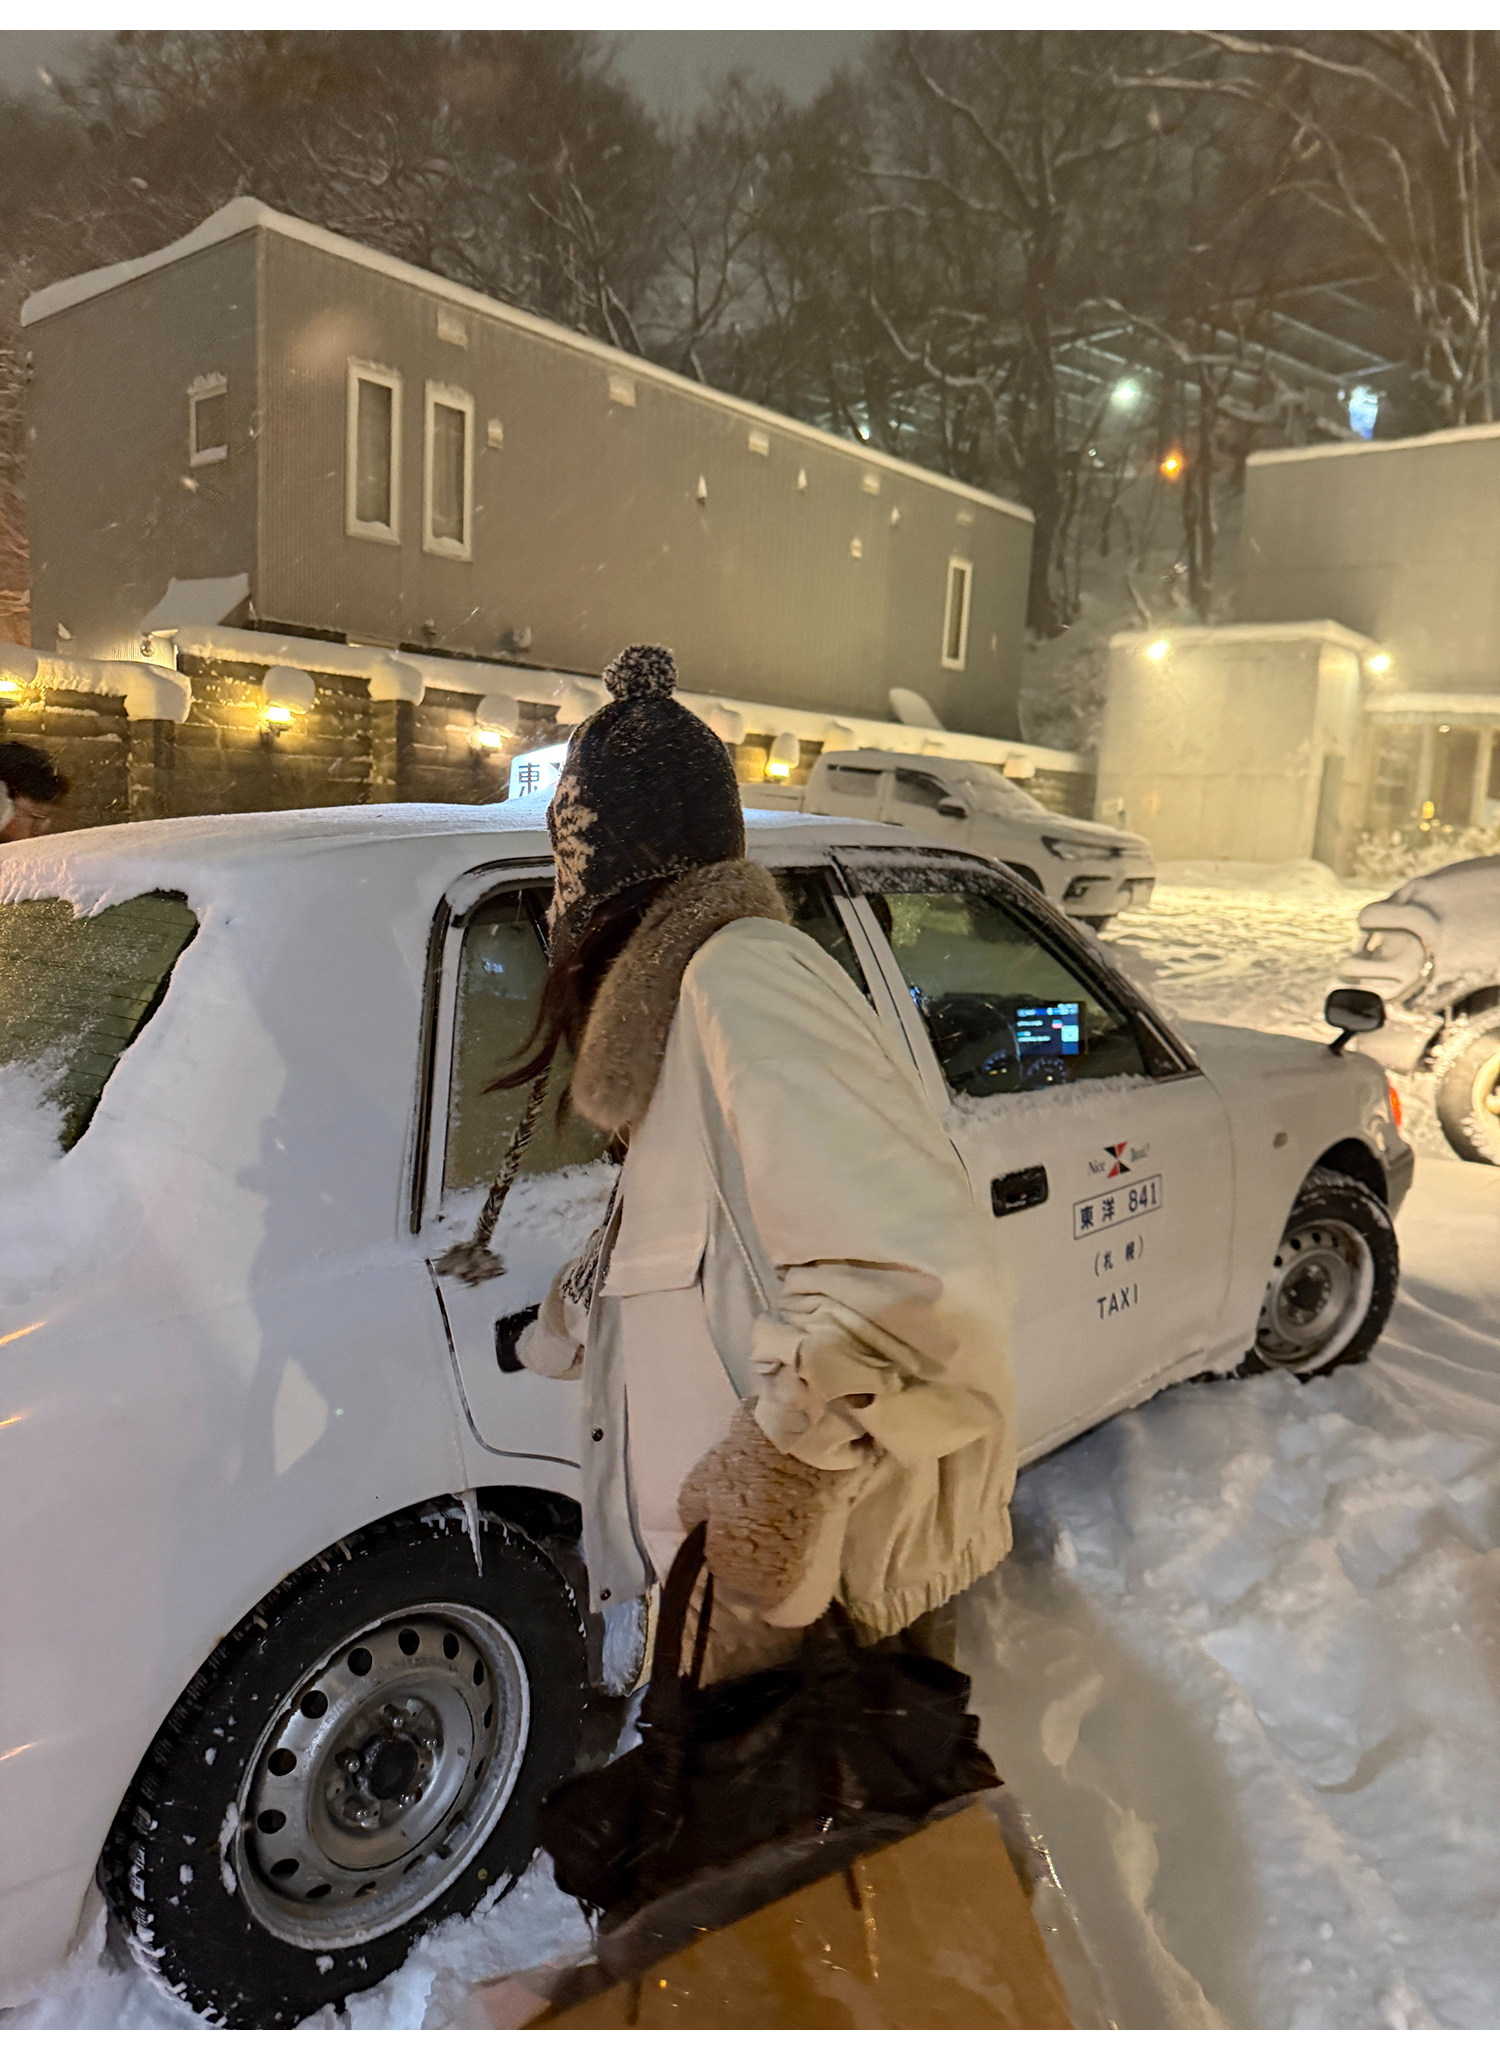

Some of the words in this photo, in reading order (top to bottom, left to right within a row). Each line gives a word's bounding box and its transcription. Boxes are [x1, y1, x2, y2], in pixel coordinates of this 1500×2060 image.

[518, 762, 540, 798] 東
[1127, 1181, 1158, 1213] 841
[1096, 1282, 1139, 1321] TAXI
